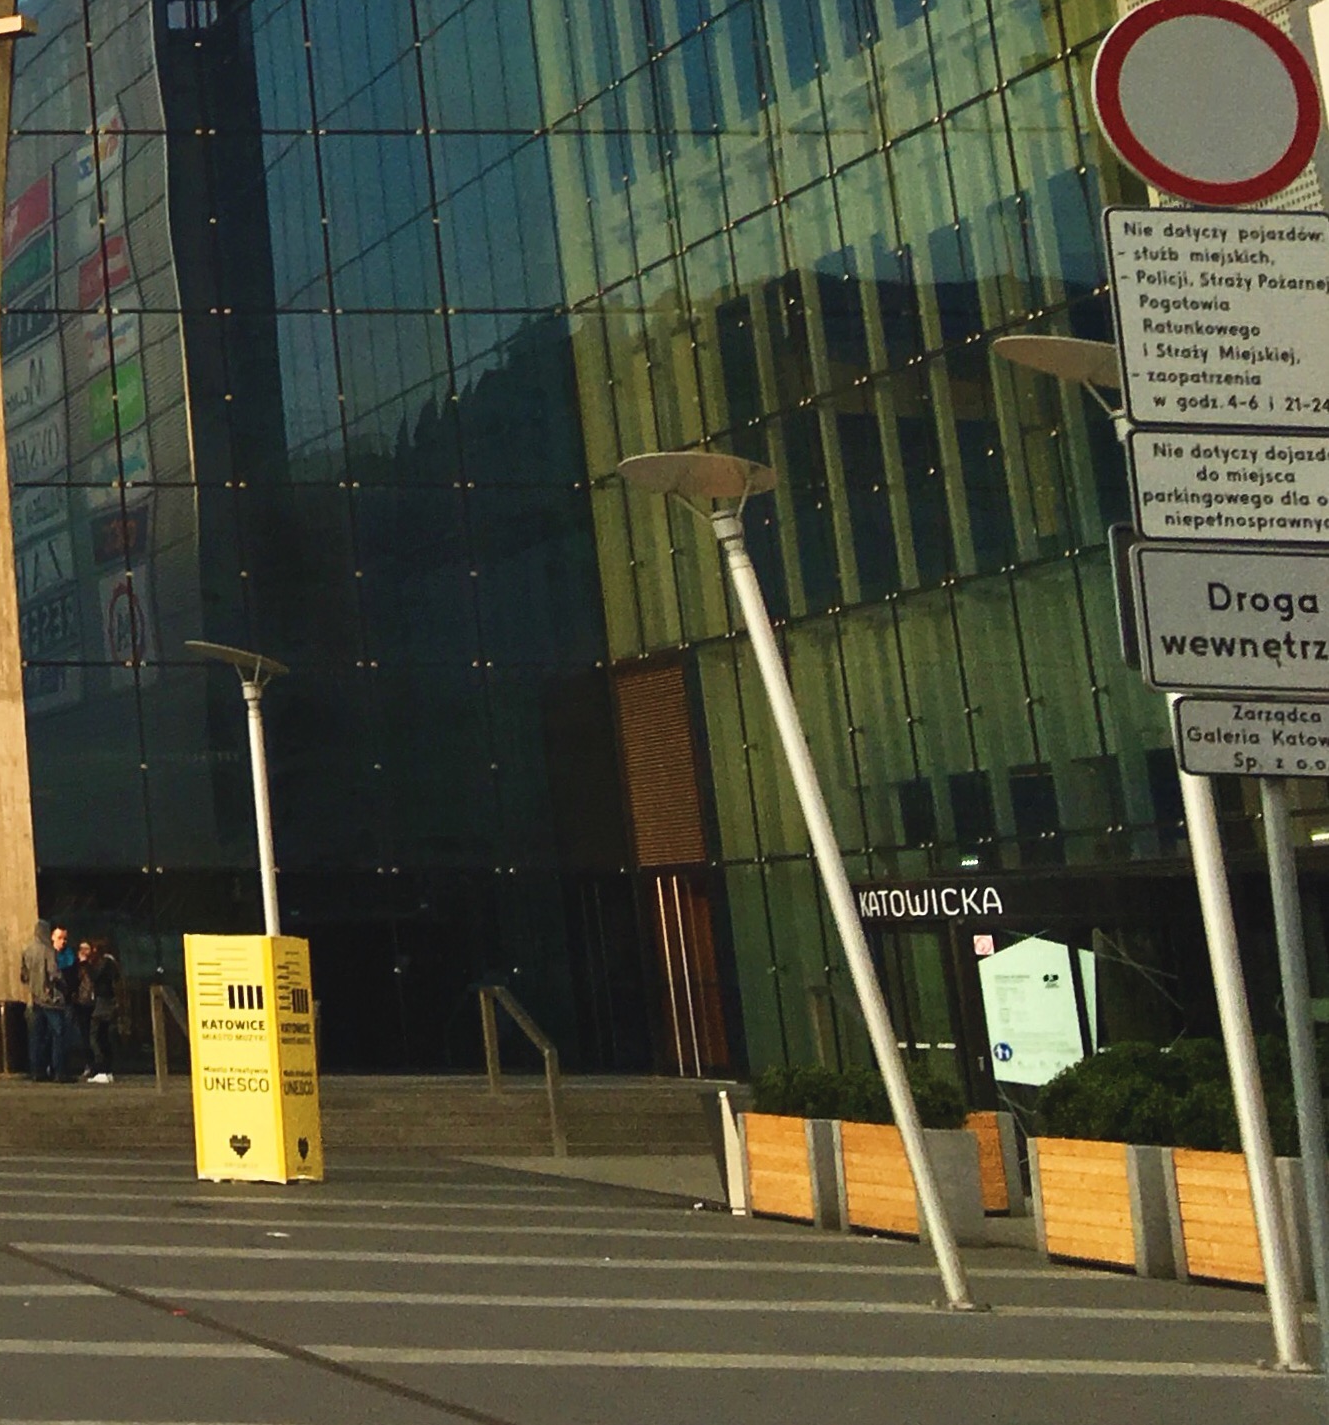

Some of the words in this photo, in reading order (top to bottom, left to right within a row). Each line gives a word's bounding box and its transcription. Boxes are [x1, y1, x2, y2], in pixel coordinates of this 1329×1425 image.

[1123, 222, 1154, 237] Nie
[1164, 223, 1228, 242] dotyczy
[1199, 271, 1252, 291] Straży
[1139, 294, 1230, 313] Pogotowia
[1143, 318, 1261, 340] Ratunkowego
[1156, 342, 1208, 363] Straży
[1147, 370, 1262, 387] zaopatrzenia
[1153, 395, 1166, 408] w
[1153, 442, 1184, 458] Nie
[1191, 444, 1258, 464] dotyczy
[1265, 445, 1329, 465] dojazd
[1196, 464, 1220, 482] do
[1226, 467, 1296, 487] miejsca
[1143, 487, 1274, 509] parkingowego
[1281, 489, 1310, 506] dla
[1208, 582, 1320, 621] Droga
[1161, 631, 1329, 669] wewnętrz
[1233, 705, 1322, 726] Zarządca
[1187, 726, 1260, 746] Galeria
[859, 886, 1004, 918] KATOWICKA
[202, 1019, 266, 1031] KATOWICE
[204, 1076, 270, 1093] UNESCO
